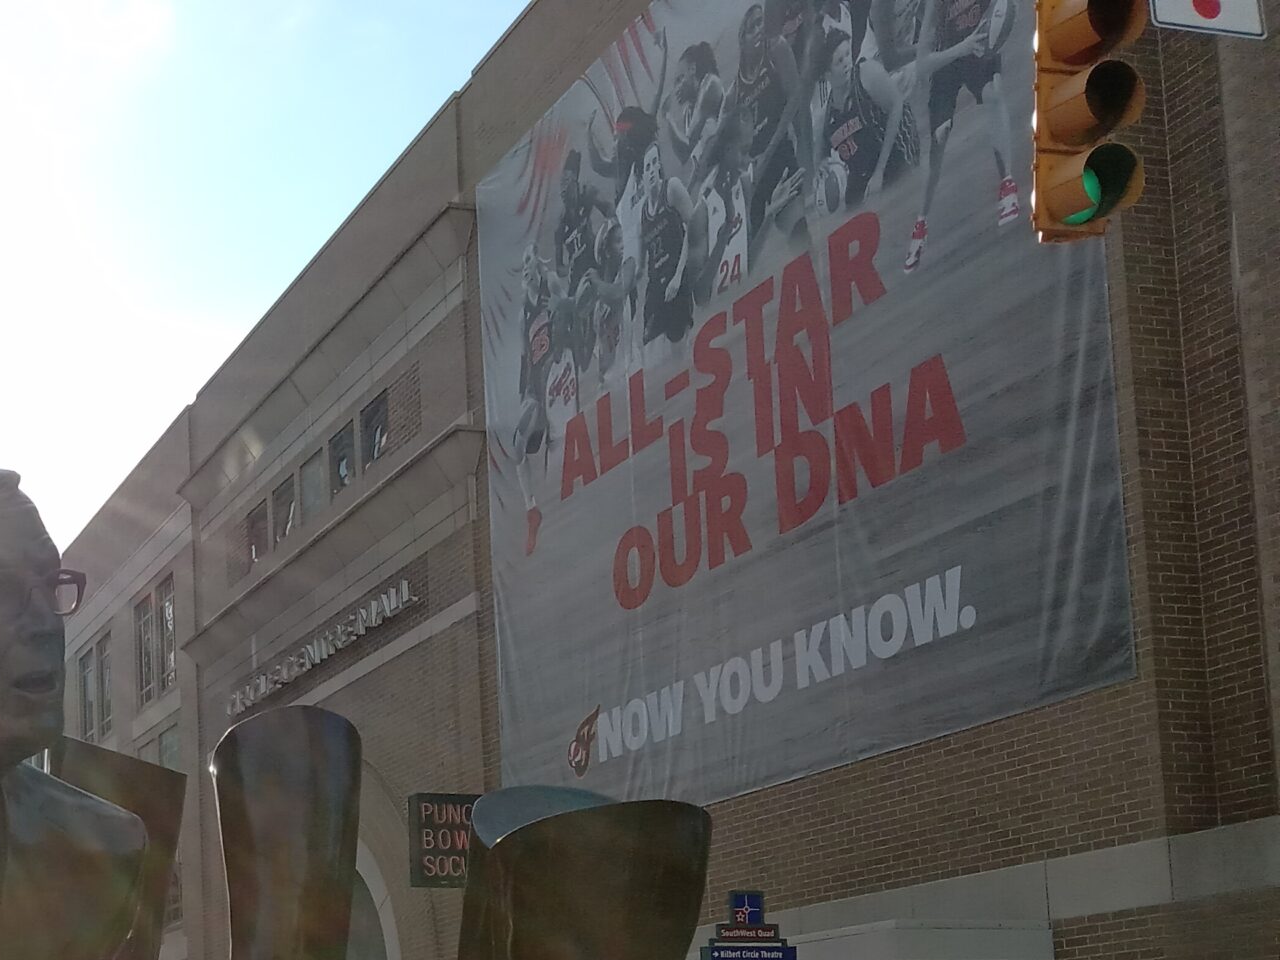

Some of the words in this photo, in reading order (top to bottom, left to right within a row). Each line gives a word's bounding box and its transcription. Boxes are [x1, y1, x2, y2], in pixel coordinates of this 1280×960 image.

[717, 254, 741, 294] 24
[560, 211, 887, 502] ALL-STAR
[668, 390, 729, 507] IS
[751, 328, 834, 458] IN
[613, 471, 752, 610] OUR
[774, 353, 967, 536] DNA
[356, 577, 420, 635] MALL
[596, 680, 685, 763] NOW
[693, 640, 784, 725] YOU
[796, 565, 977, 690] KNOW.
[742, 950, 759, 958] Circle
[760, 950, 783, 959] Theatre
[757, 929, 775, 937] Quad
